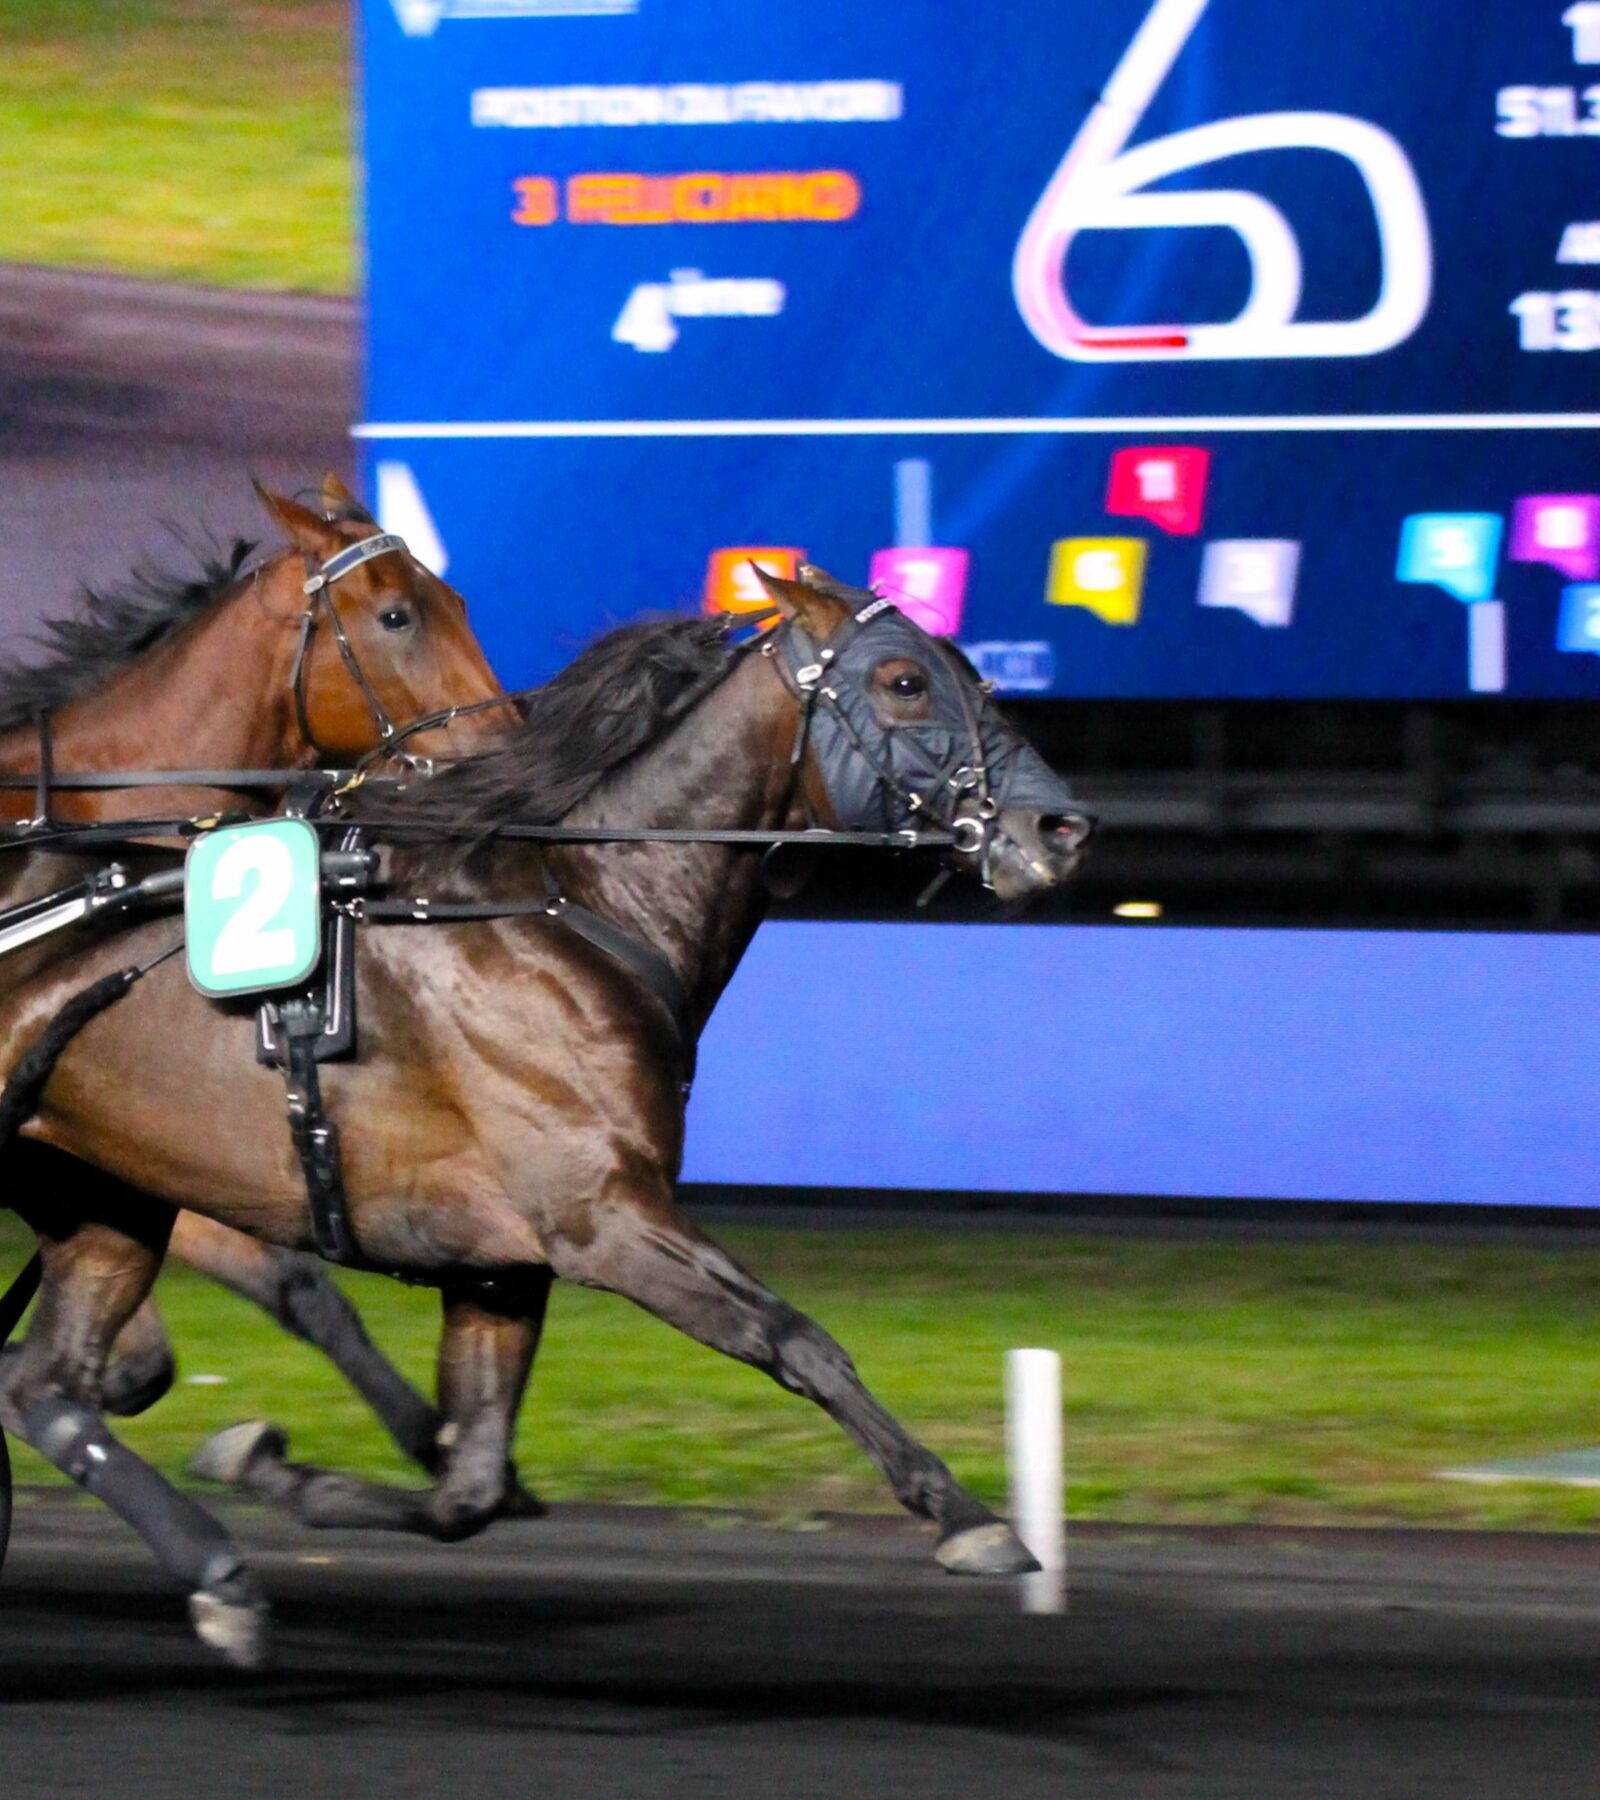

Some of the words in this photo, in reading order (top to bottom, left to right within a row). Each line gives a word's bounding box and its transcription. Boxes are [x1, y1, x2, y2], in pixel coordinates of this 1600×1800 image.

[512, 177, 558, 225] 3
[1135, 460, 1176, 500] 1
[1073, 549, 1126, 591] 6
[212, 835, 296, 976] 2
